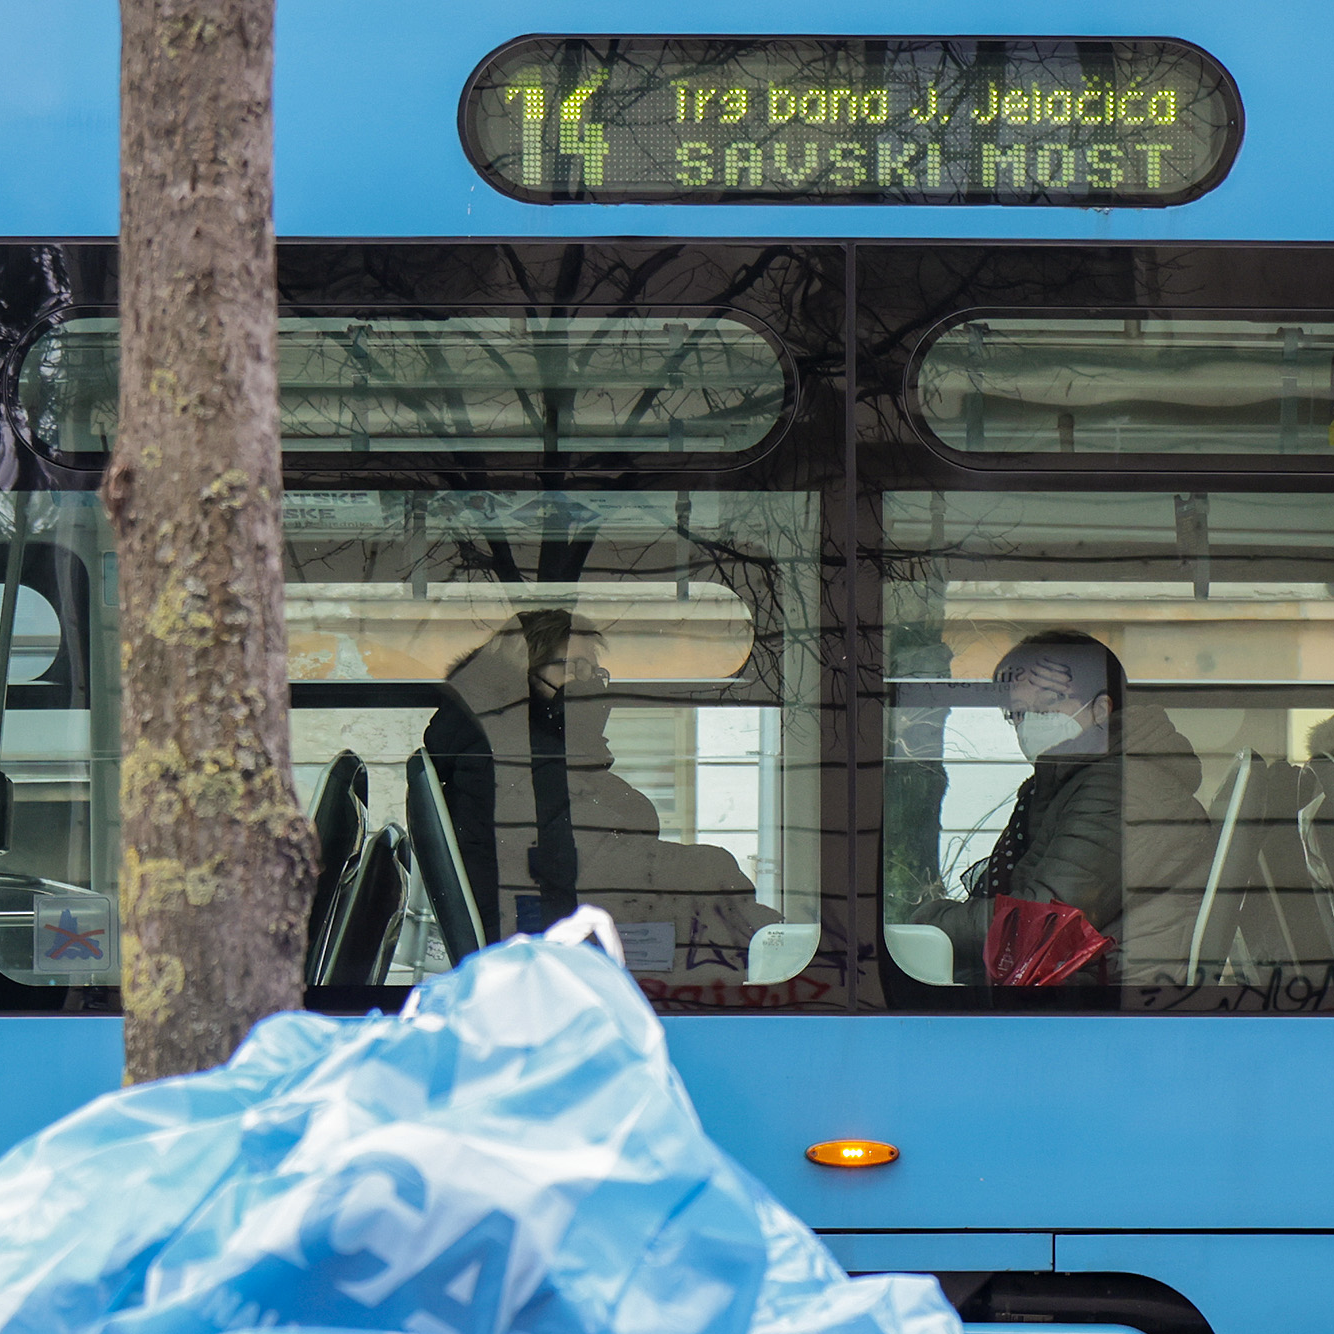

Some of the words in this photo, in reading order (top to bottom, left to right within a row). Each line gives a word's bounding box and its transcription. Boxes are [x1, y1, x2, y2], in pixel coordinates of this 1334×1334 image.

[670, 81, 748, 124] Trg
[768, 80, 890, 124] bana
[505, 67, 609, 186] 14
[676, 142, 941, 187] SAVSKI
[982, 143, 1174, 188] MOST
